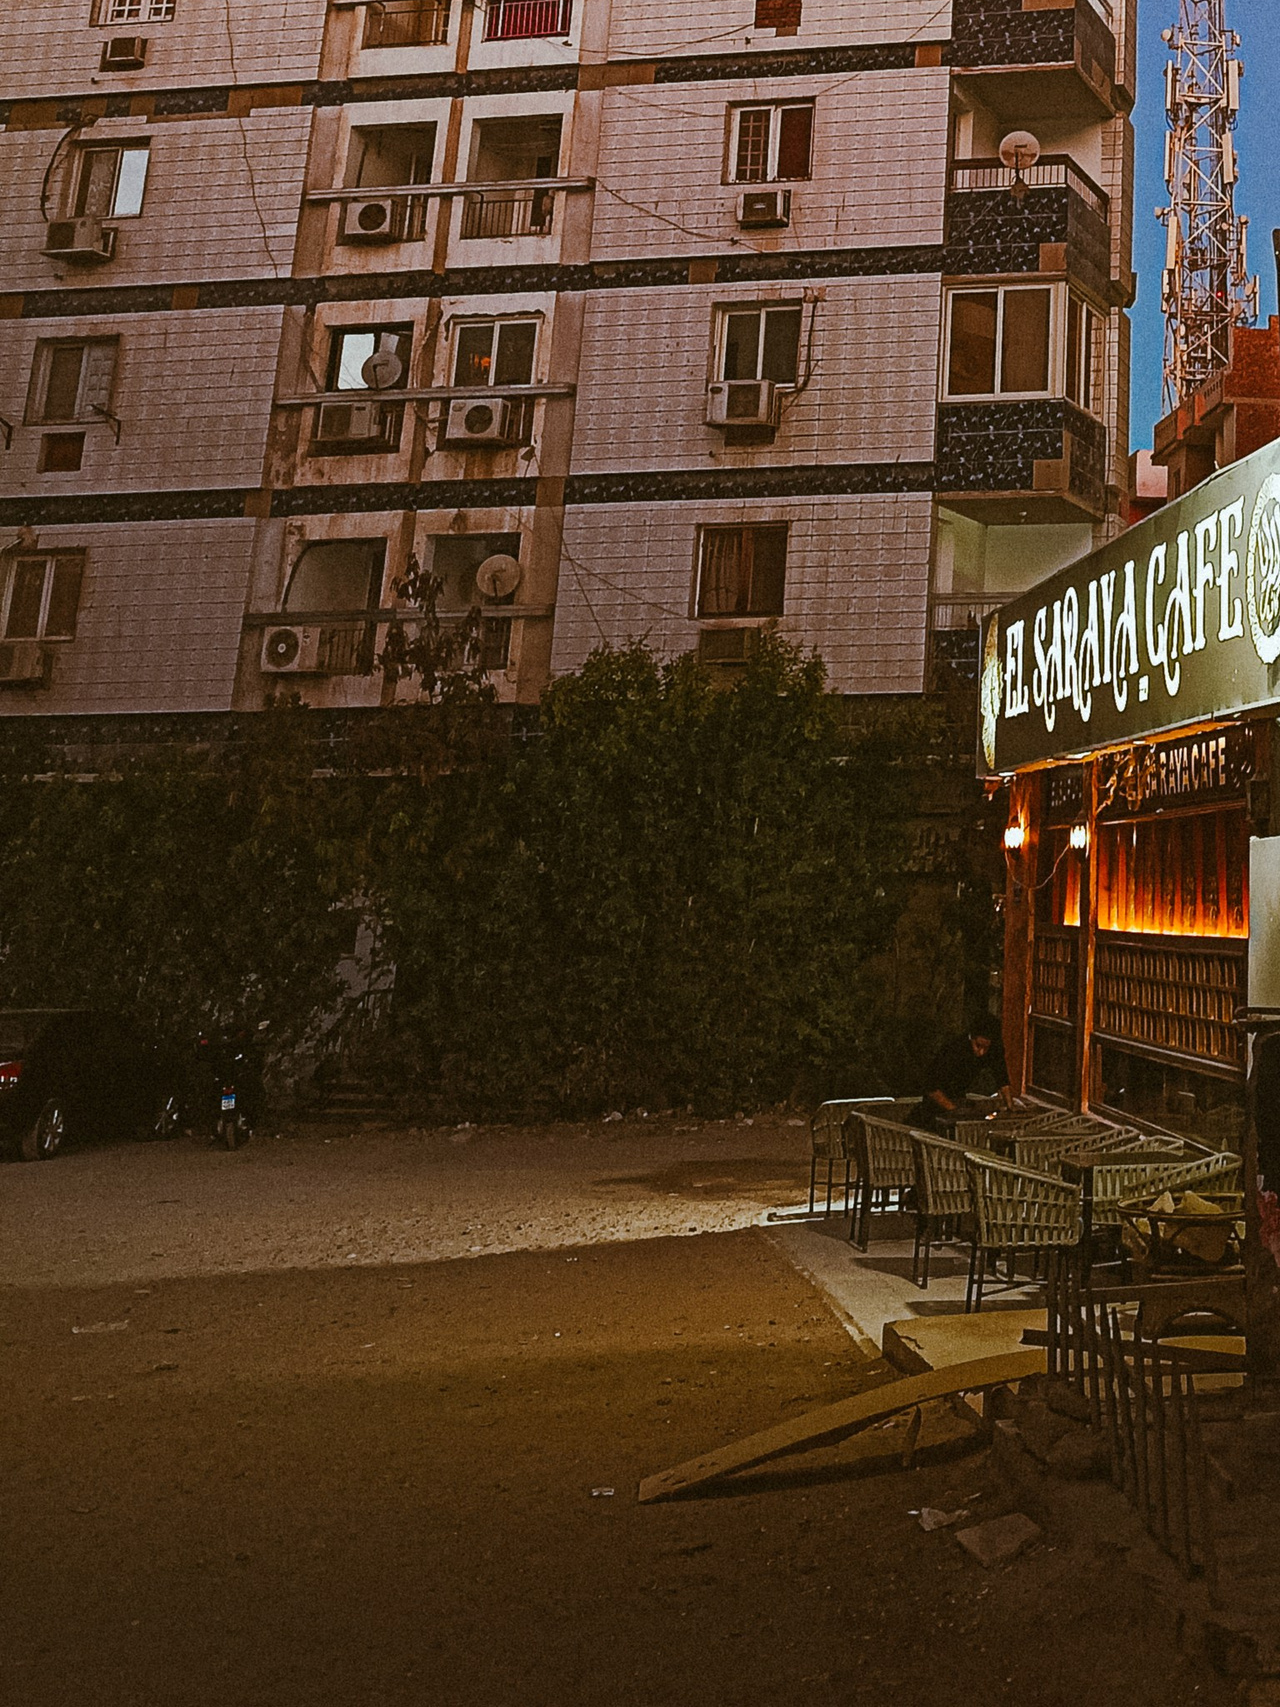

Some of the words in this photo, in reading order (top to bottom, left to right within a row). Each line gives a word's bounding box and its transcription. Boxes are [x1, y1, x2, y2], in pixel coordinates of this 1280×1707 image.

[1004, 620, 1029, 718] EL
[1033, 560, 1139, 732] SARAYA
[1146, 495, 1245, 696] CAFE
[1191, 736, 1226, 791] CAFE
